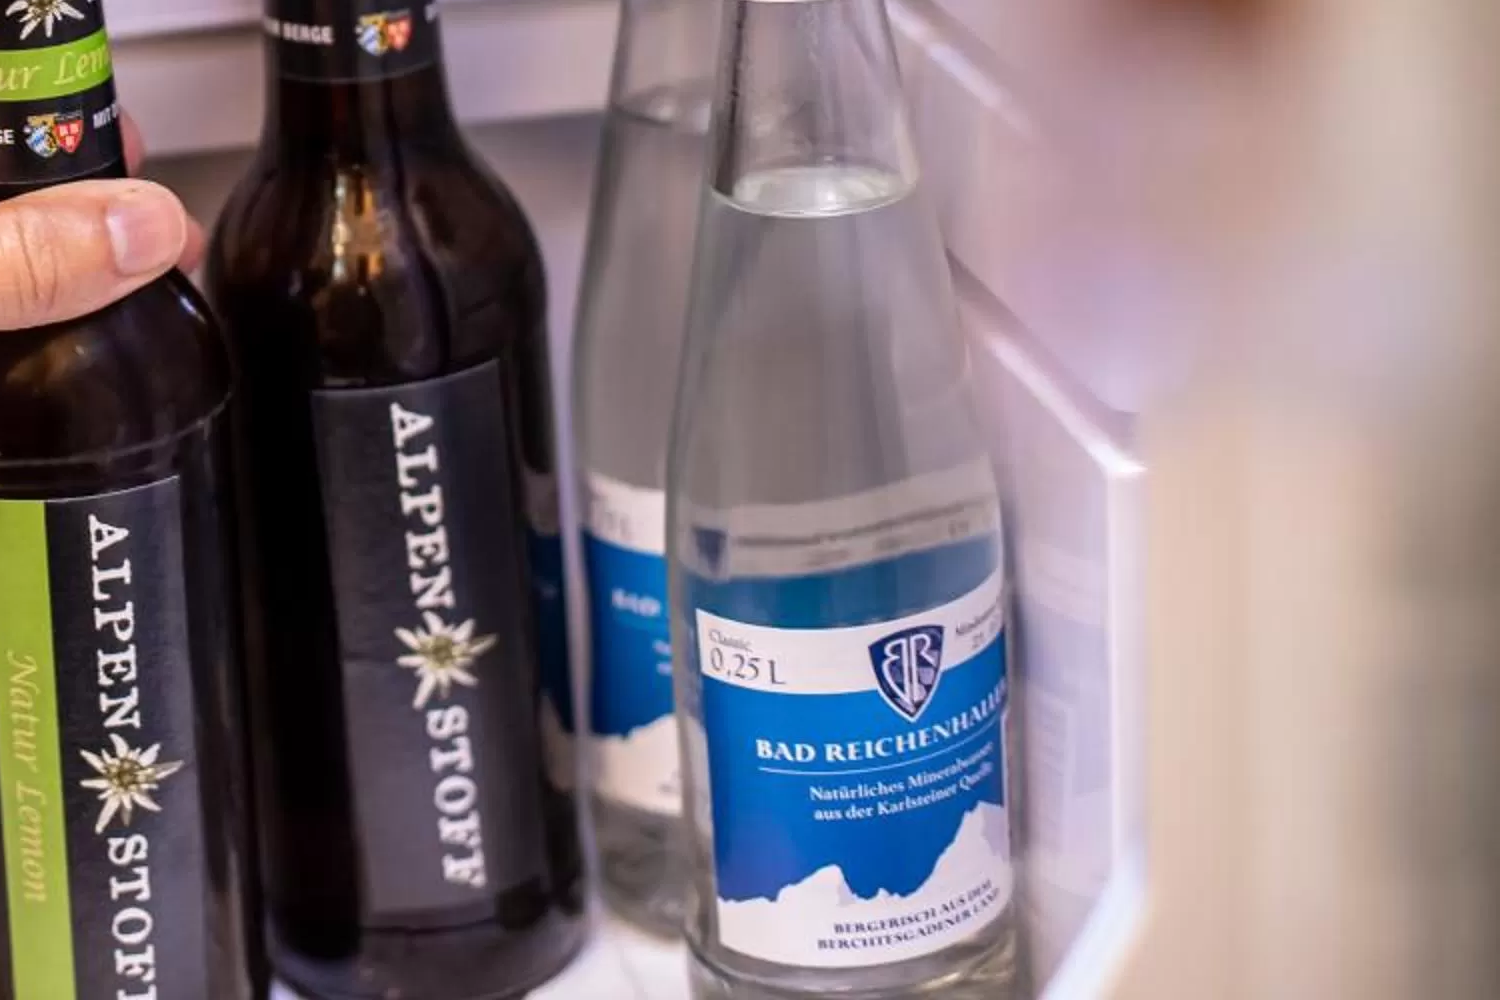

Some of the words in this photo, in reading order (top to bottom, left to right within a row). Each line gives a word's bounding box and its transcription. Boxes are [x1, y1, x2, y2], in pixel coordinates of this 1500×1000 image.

[88, 513, 142, 730] ALPEN
[389, 402, 456, 610] ALPEN
[426, 705, 486, 889] STOFF
[710, 647, 760, 681] 0,25
[768, 659, 787, 685] L
[7, 651, 42, 774] Natur
[756, 738, 815, 762] BAD
[825, 678, 1006, 762] REICHENHALL
[810, 778, 905, 801] Natürliches
[814, 808, 842, 821] aus
[846, 804, 874, 820] der
[877, 783, 957, 816] Karlsteiner
[16, 781, 50, 903] Lemon
